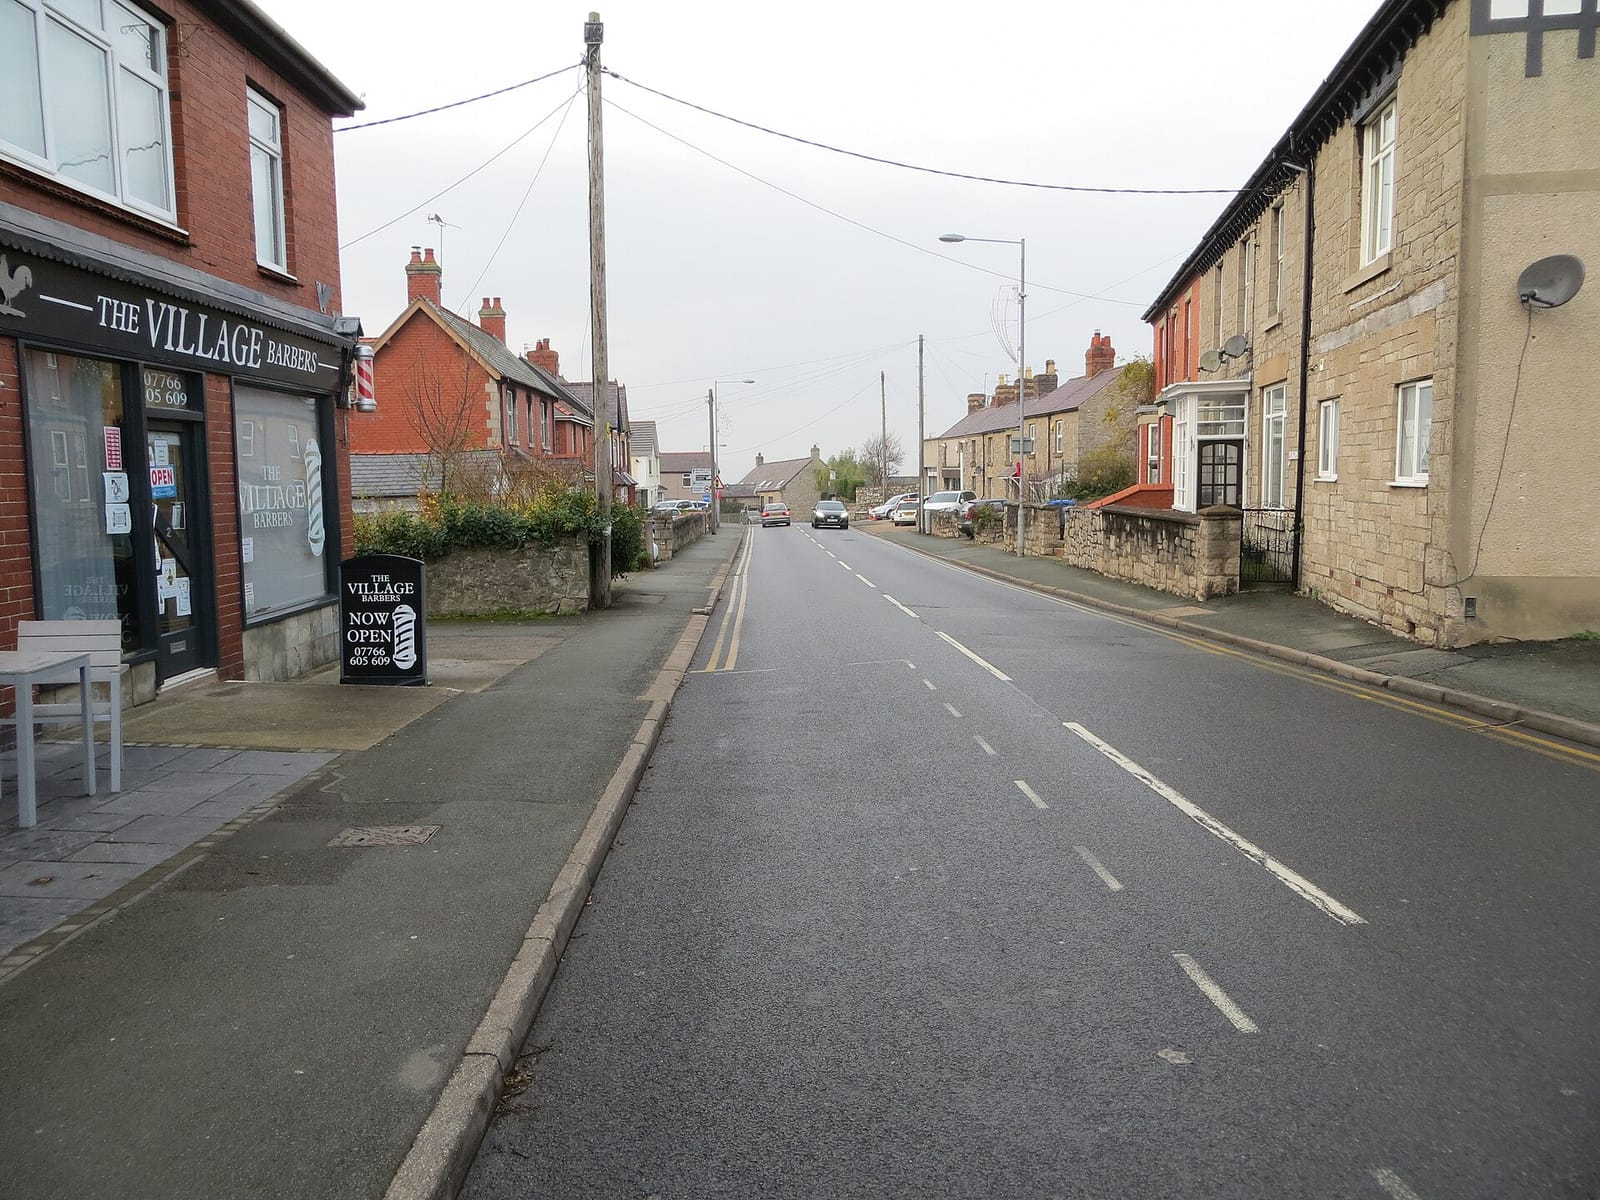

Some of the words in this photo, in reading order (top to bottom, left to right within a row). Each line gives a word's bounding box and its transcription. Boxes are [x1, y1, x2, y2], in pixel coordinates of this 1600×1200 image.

[97, 295, 141, 334] THE
[145, 298, 263, 369] VILLAGE
[266, 340, 318, 374] BARBERS
[143, 371, 182, 390] 07766
[165, 391, 187, 406] 609
[151, 469, 174, 486] OPEN
[263, 465, 280, 481] THE
[240, 482, 305, 511] VILLAGE
[254, 511, 294, 528] BARBERS
[371, 574, 390, 583] THE
[347, 582, 415, 595] VILLAGE
[361, 594, 401, 602] BARBERS
[349, 612, 390, 625] NOW
[347, 629, 392, 643] OPEN
[354, 646, 386, 656] 07766
[349, 656, 369, 666] 605
[371, 656, 390, 666] 609
